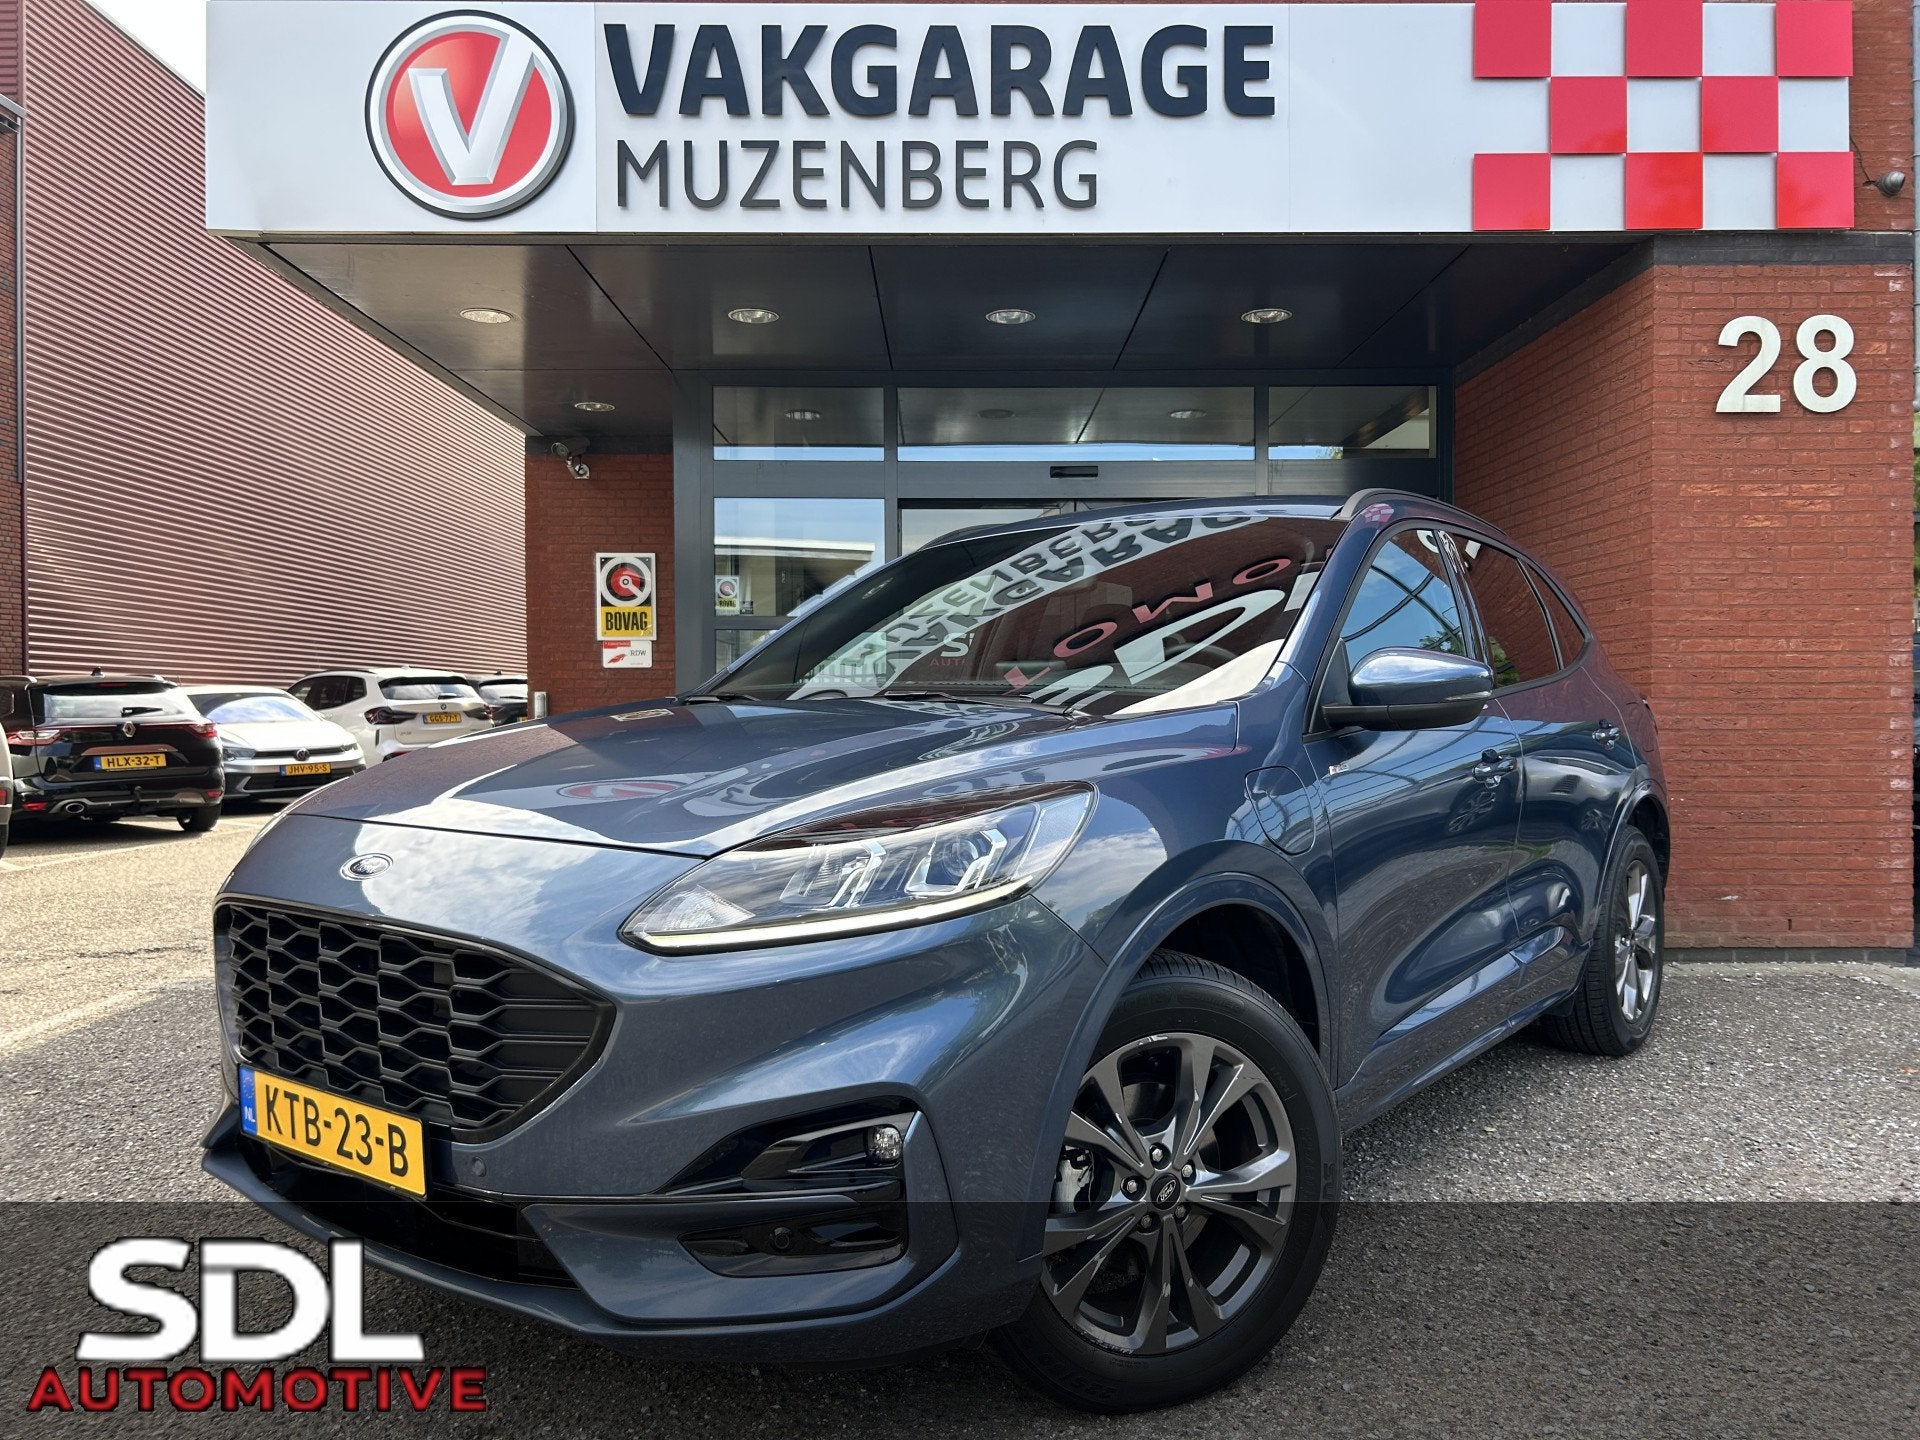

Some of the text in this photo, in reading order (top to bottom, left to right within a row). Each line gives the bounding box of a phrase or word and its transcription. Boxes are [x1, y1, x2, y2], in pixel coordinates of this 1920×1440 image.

[603, 24, 1276, 118] VAKGARAGE
[616, 139, 1099, 210] MUZENBERG
[1715, 314, 1857, 413] 28
[605, 611, 648, 632] BOVAG
[630, 649, 647, 657] RDW
[106, 755, 161, 768] HLX-32-T
[288, 764, 328, 774] JHV-95-S
[244, 1084, 409, 1178] NL KTB-23-B
